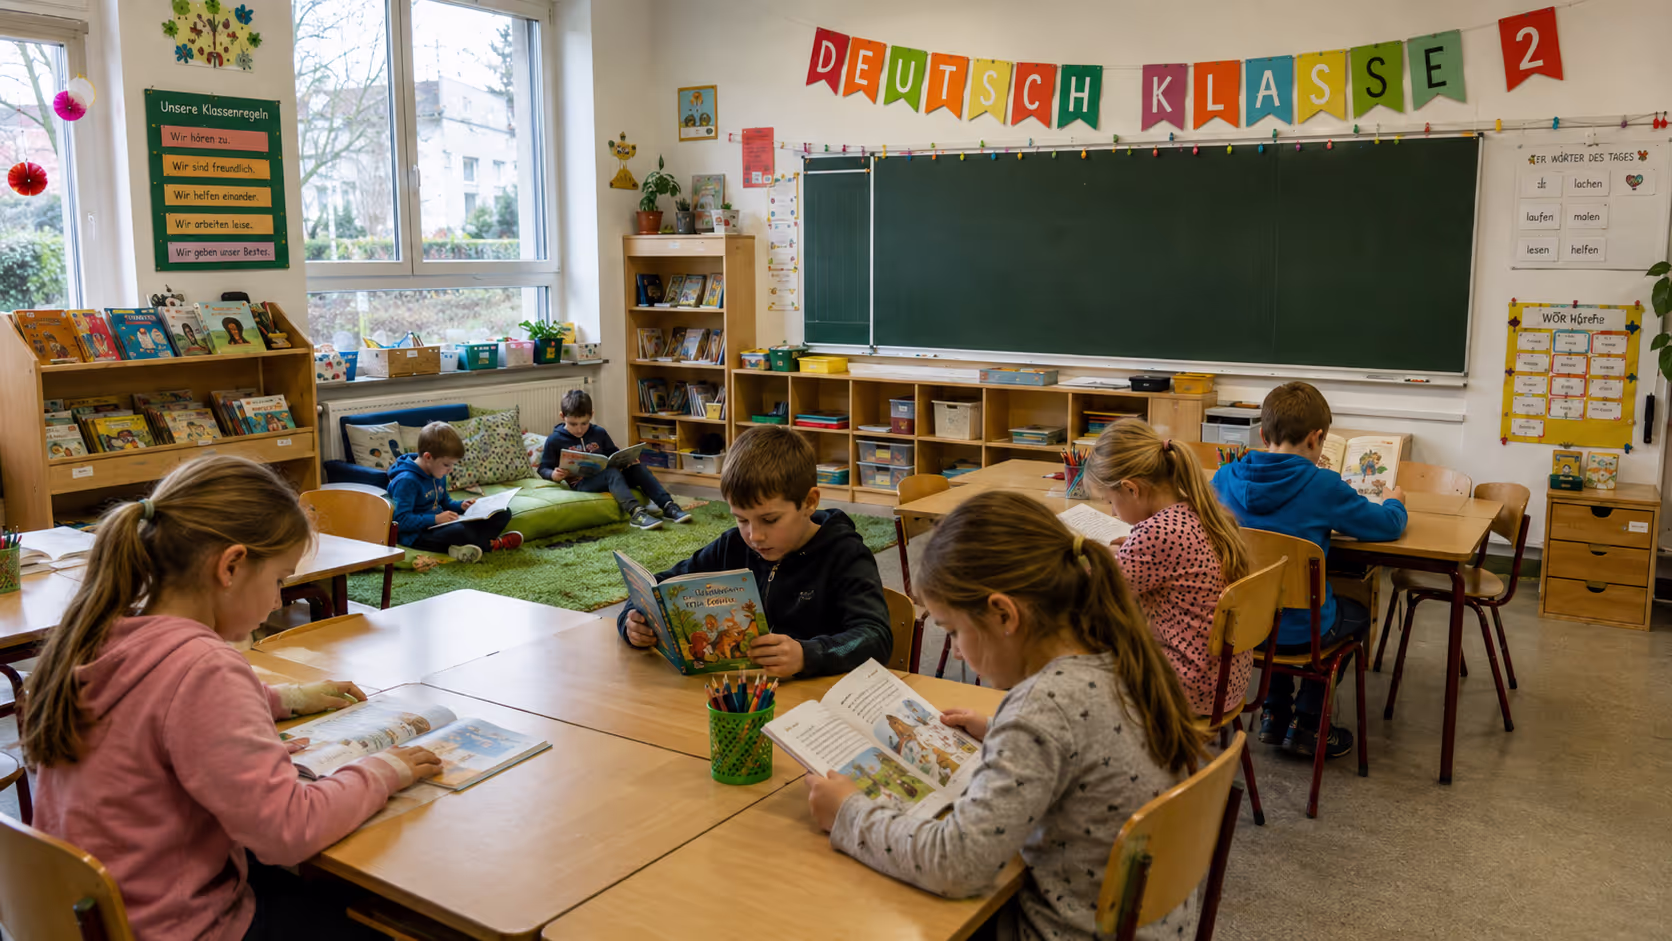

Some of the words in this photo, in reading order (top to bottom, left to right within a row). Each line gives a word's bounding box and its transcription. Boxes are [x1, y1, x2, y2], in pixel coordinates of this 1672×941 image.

[816, 39, 1091, 113] DEUTSCH
[1151, 45, 1448, 114] KLASSE
[1515, 26, 1545, 71] 2
[160, 101, 198, 114] Unsere
[202, 104, 269, 122] Klassenregeln
[170, 132, 188, 142] Wir
[190, 132, 215, 144] hören
[218, 135, 231, 145] zu.
[1588, 153, 1604, 163] DES
[1608, 152, 1634, 162] TAGES
[172, 161, 189, 171] Wir
[192, 161, 209, 172] sind
[212, 162, 256, 174] freundlich.
[1574, 178, 1603, 189] lachen
[173, 190, 190, 200] Wir
[193, 190, 220, 201] helfen
[222, 191, 260, 202] einander.
[1526, 212, 1554, 223] laufen
[1574, 212, 1600, 221] malen
[175, 219, 191, 229] Wir
[194, 219, 229, 229] arbeiten
[232, 219, 253, 230] leise.
[176, 247, 192, 257] Wir
[194, 248, 218, 260] geben
[219, 248, 241, 257] unser
[243, 246, 271, 257] Bestes.
[1526, 245, 1550, 255] lesen
[1570, 244, 1599, 255] helfen
